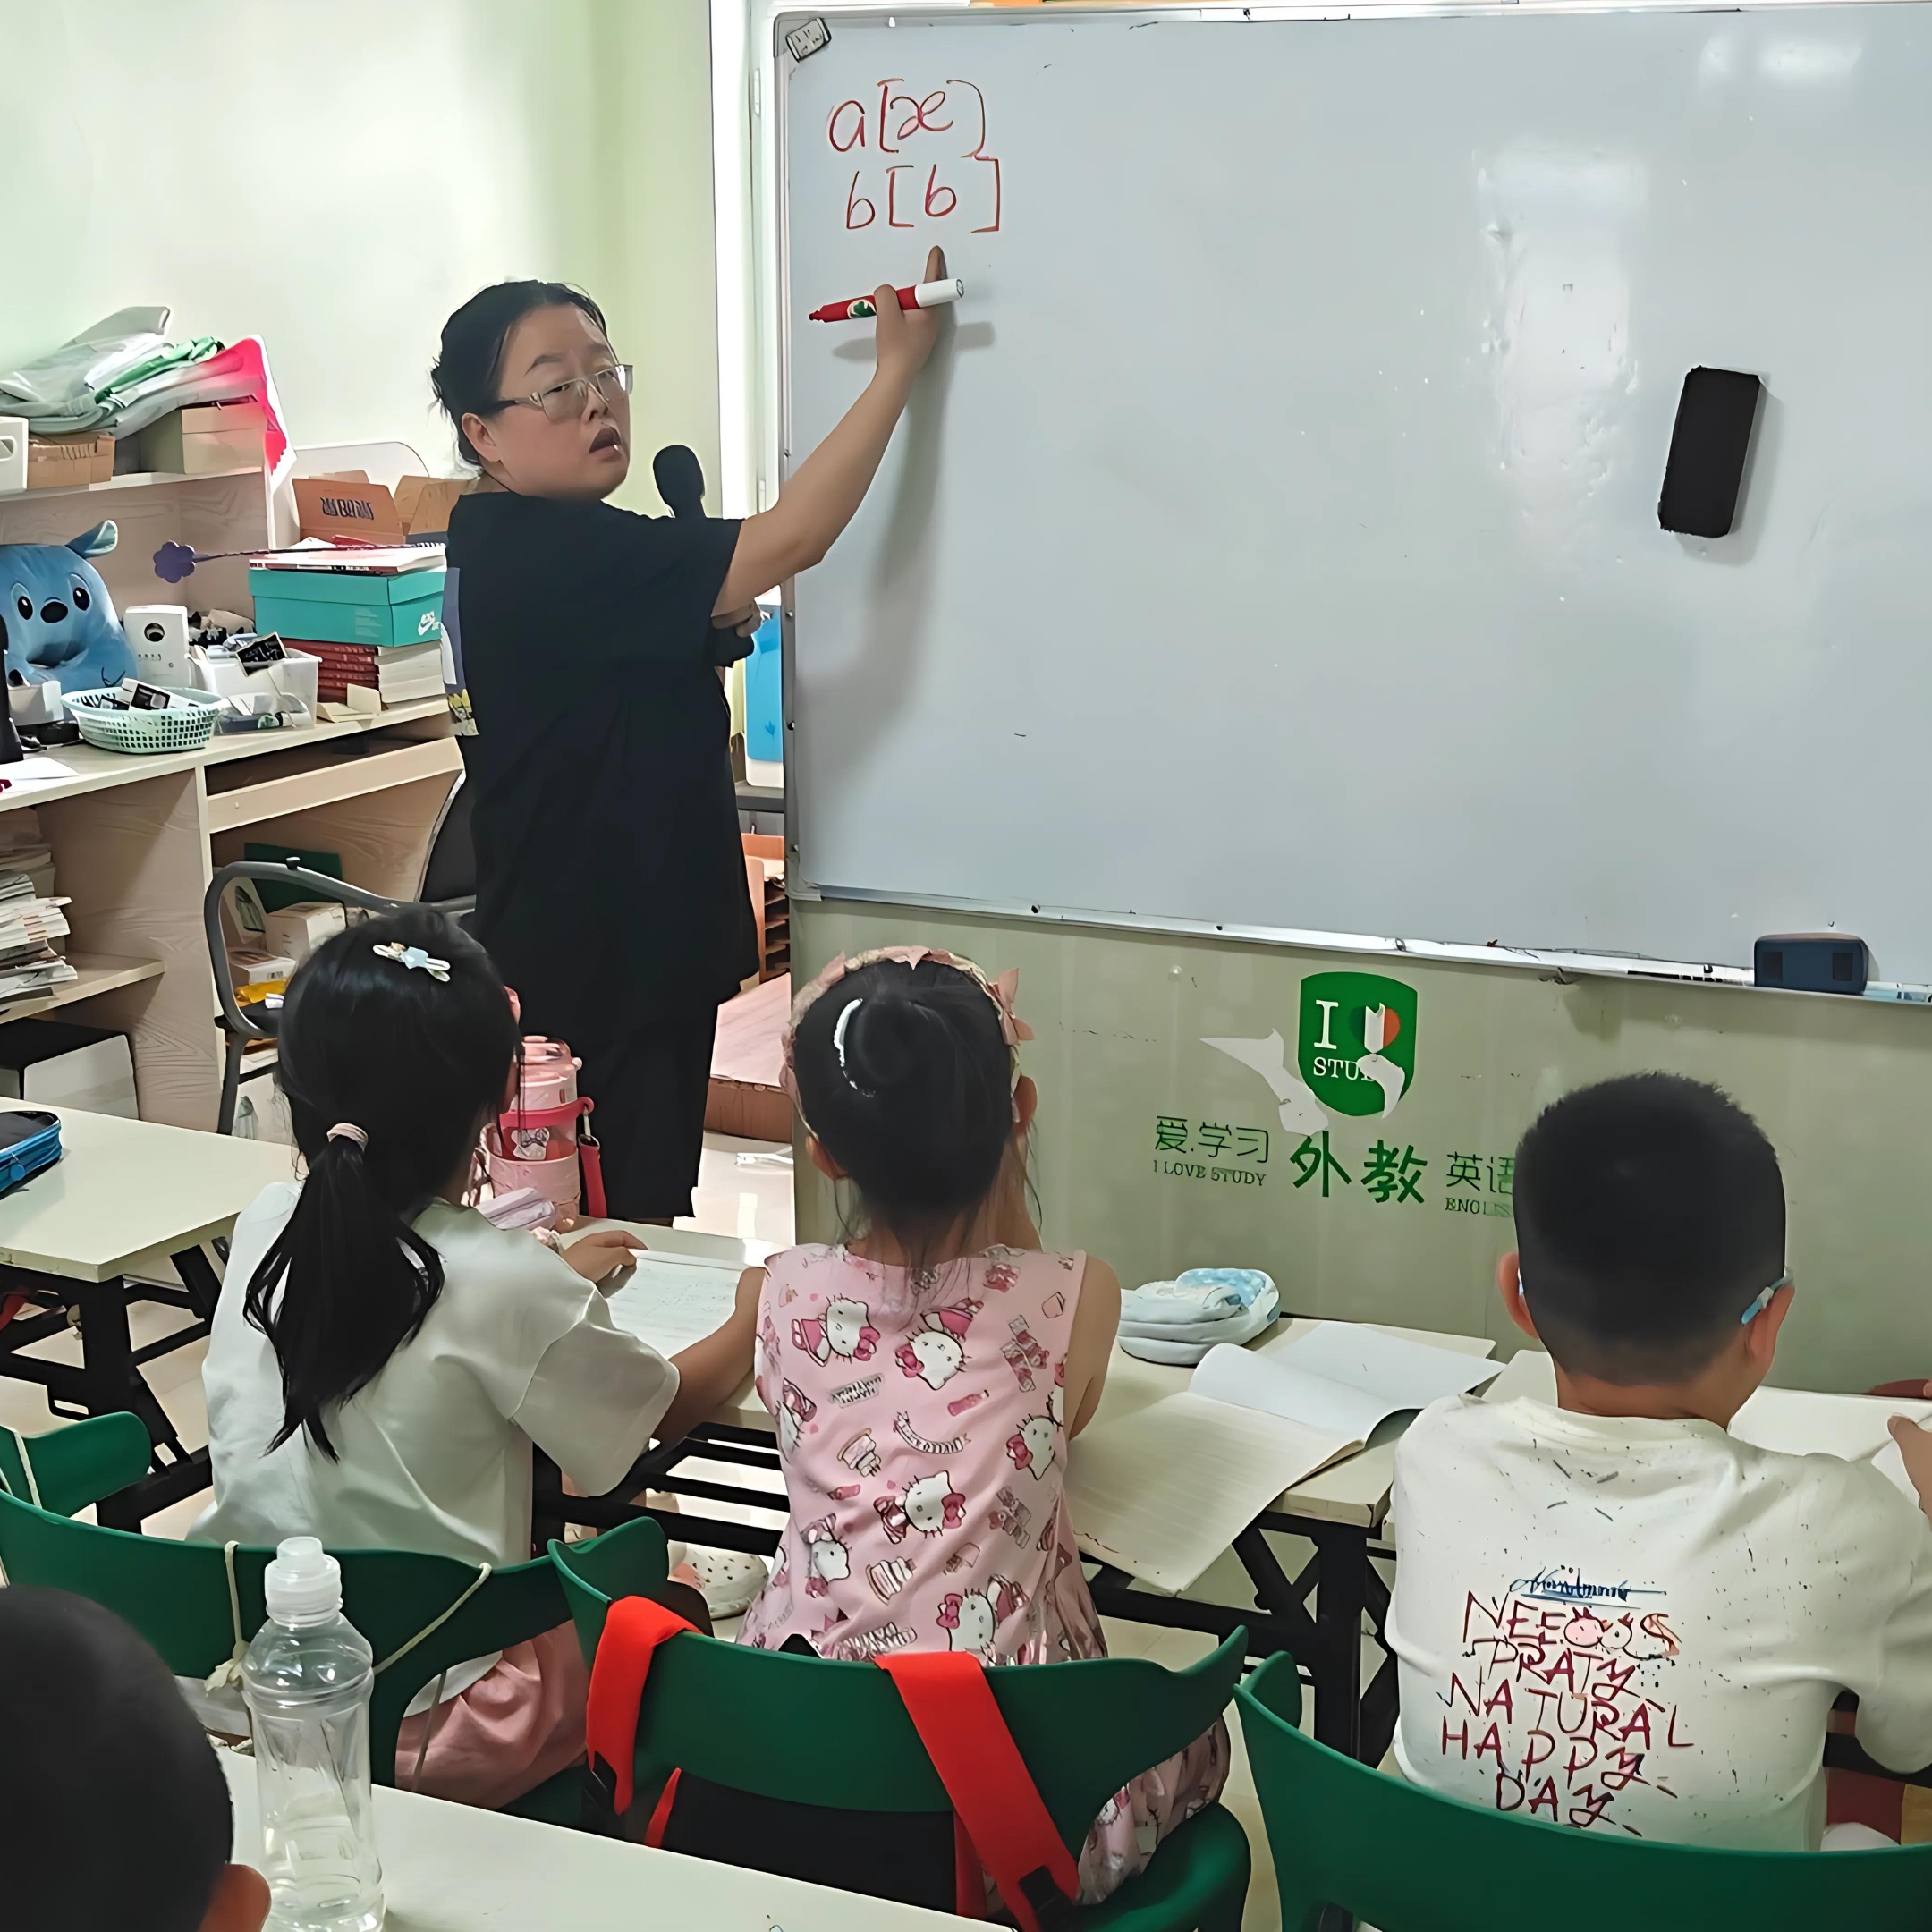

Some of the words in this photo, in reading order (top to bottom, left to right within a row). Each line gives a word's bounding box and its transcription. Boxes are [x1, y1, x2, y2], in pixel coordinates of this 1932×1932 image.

[1313, 999, 1339, 1050] I
[1313, 1056, 1375, 1082] STU
[1164, 1161, 1206, 1179] LOVE
[1211, 1166, 1267, 1186] STUDY
[1289, 1130, 1428, 1204] 外教
[1446, 1150, 1515, 1196] 英语
[1436, 1665, 1694, 1750] NATURAL
[1441, 1715, 1651, 1791] HAPPY
[1496, 1771, 1616, 1828] DAY
